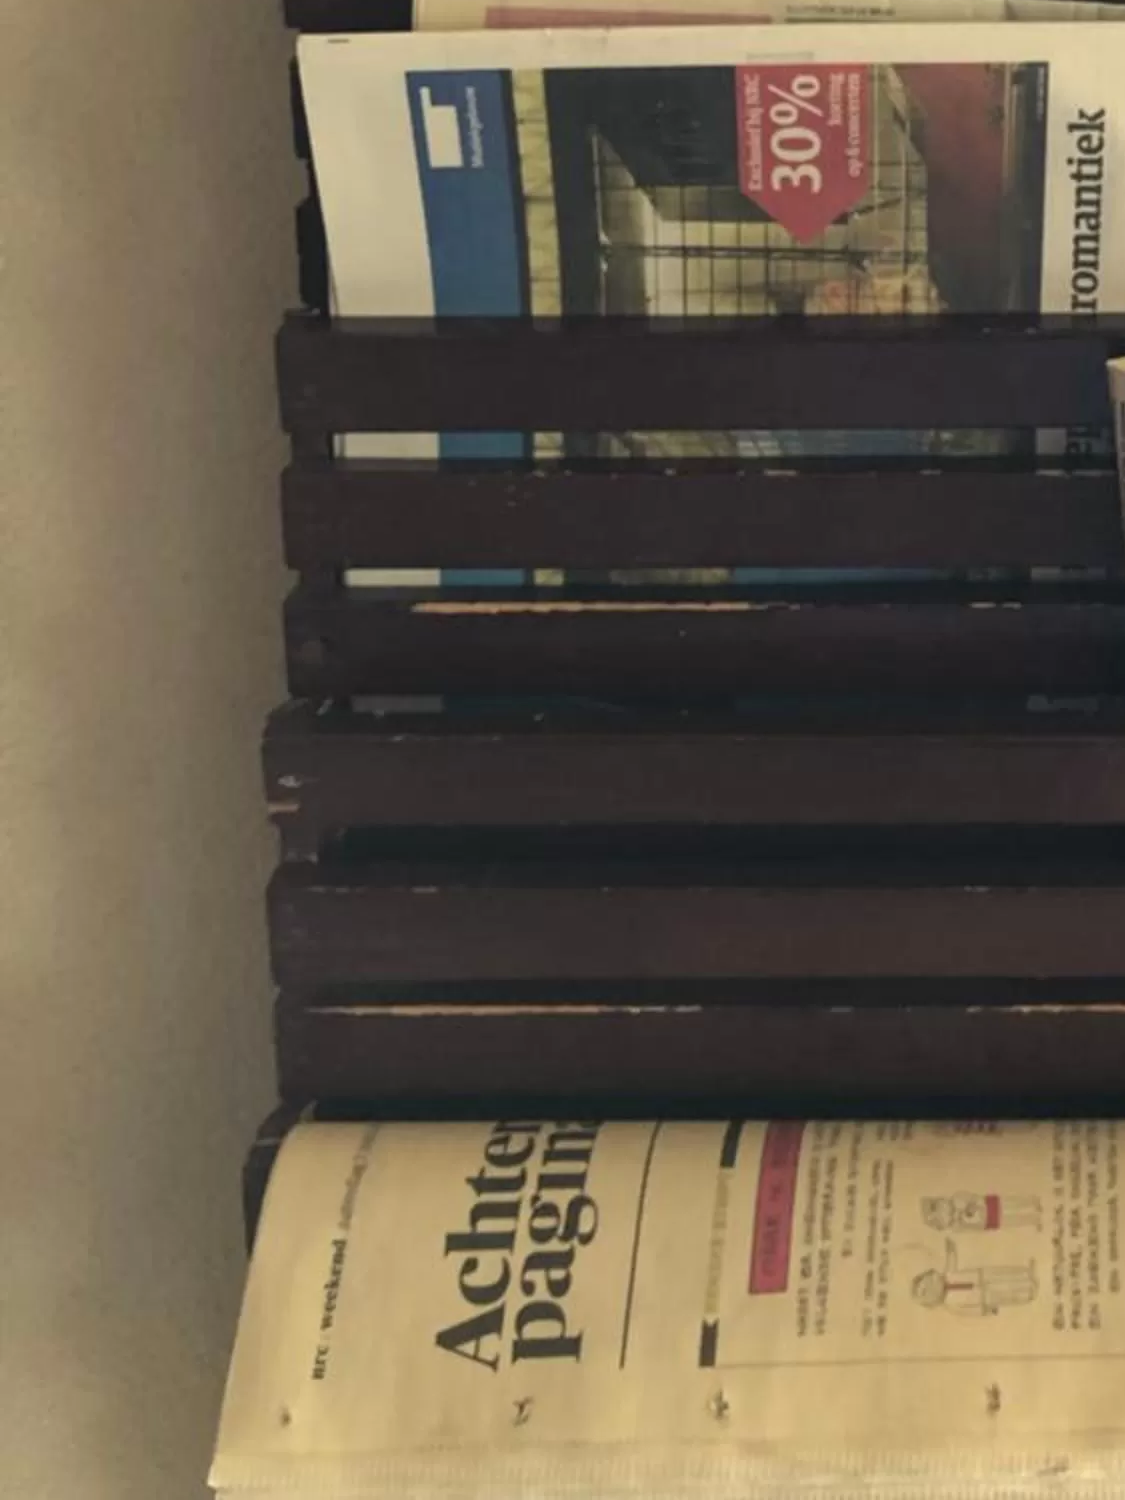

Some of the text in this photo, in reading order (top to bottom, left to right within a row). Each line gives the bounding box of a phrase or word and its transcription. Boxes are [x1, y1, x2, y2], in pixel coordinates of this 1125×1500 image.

[767, 74, 824, 193] 30%
[316, 1237, 347, 1332] weekend
[509, 1119, 598, 1364] pagin
[309, 1343, 329, 1381] nrc
